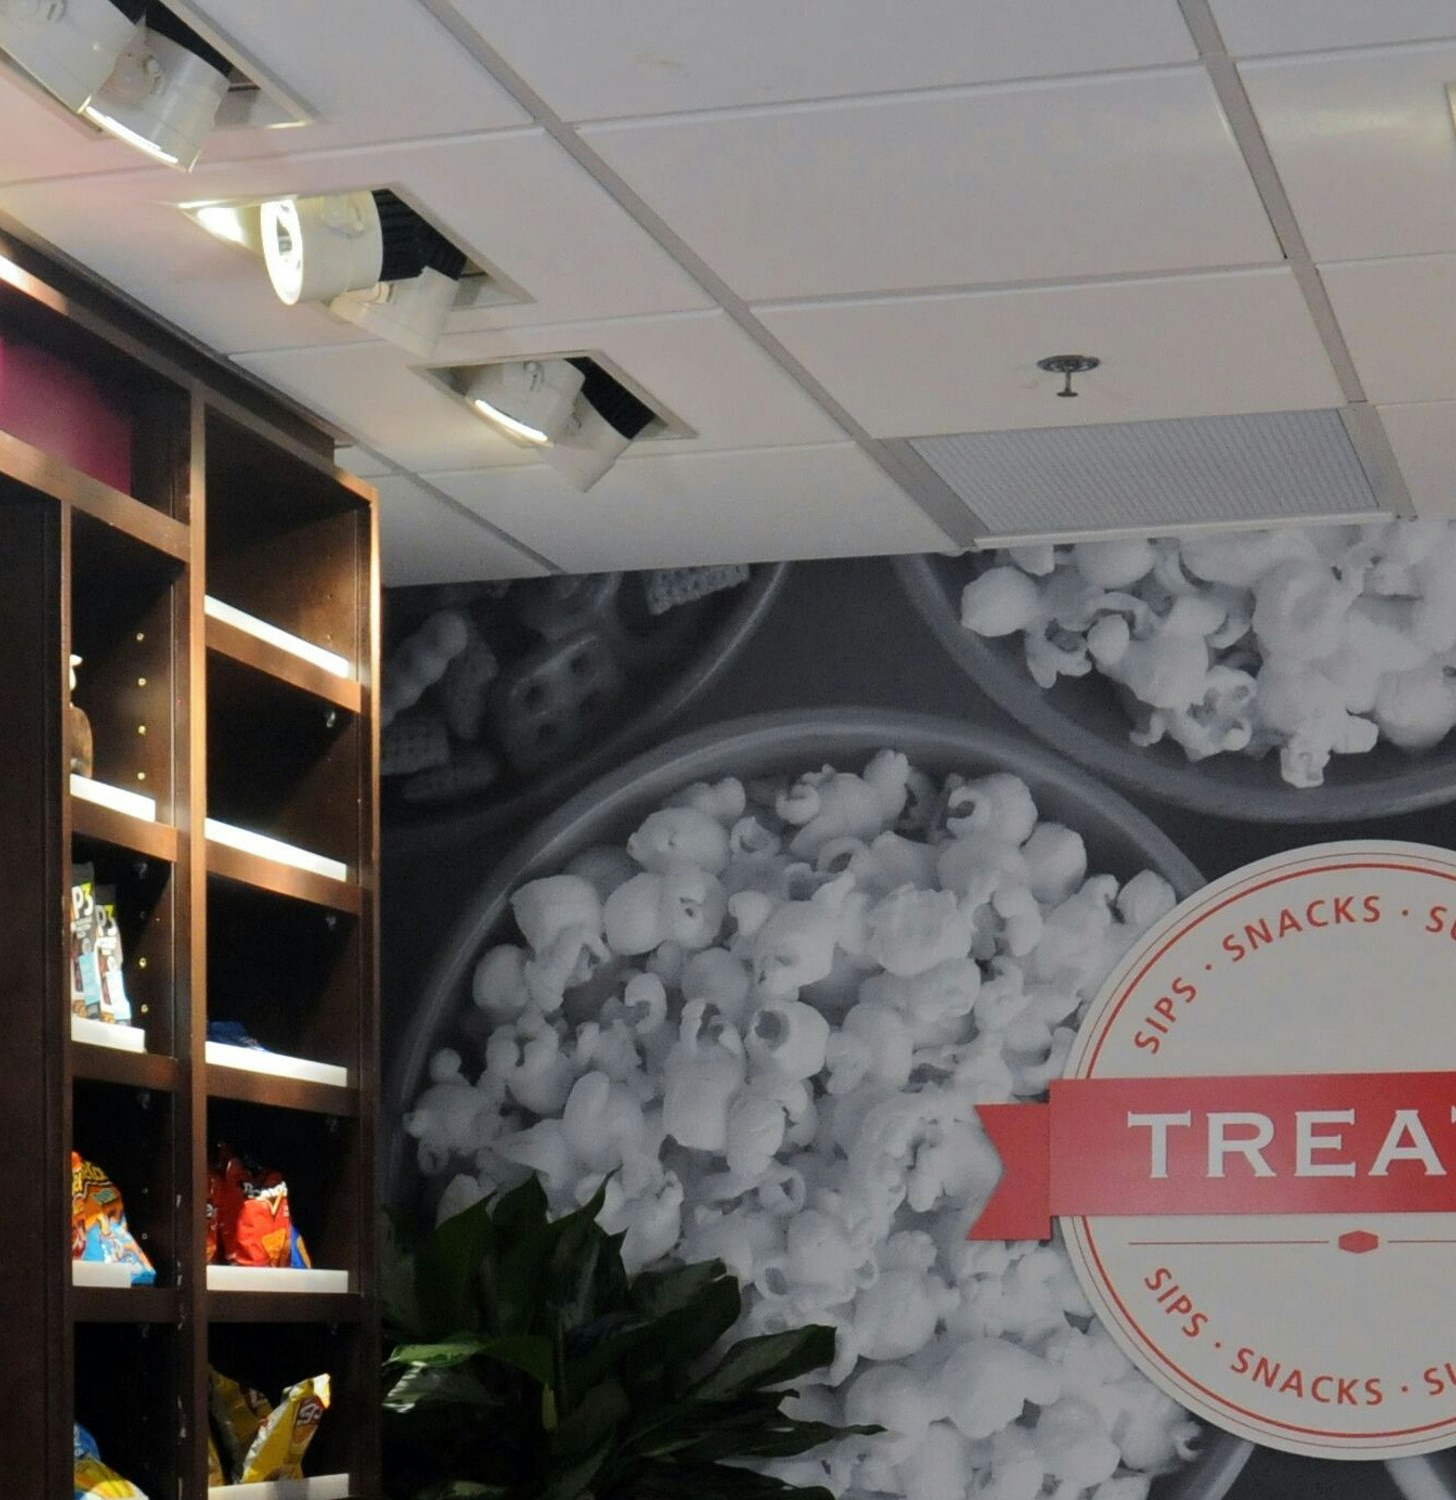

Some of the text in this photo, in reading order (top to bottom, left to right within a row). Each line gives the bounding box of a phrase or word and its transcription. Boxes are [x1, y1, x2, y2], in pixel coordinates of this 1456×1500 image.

[1135, 976, 1197, 1055] SIPS
[1222, 895, 1383, 963] SNACKS
[1145, 1267, 1210, 1340] SIPS
[1230, 1346, 1384, 1405] SNACKS
